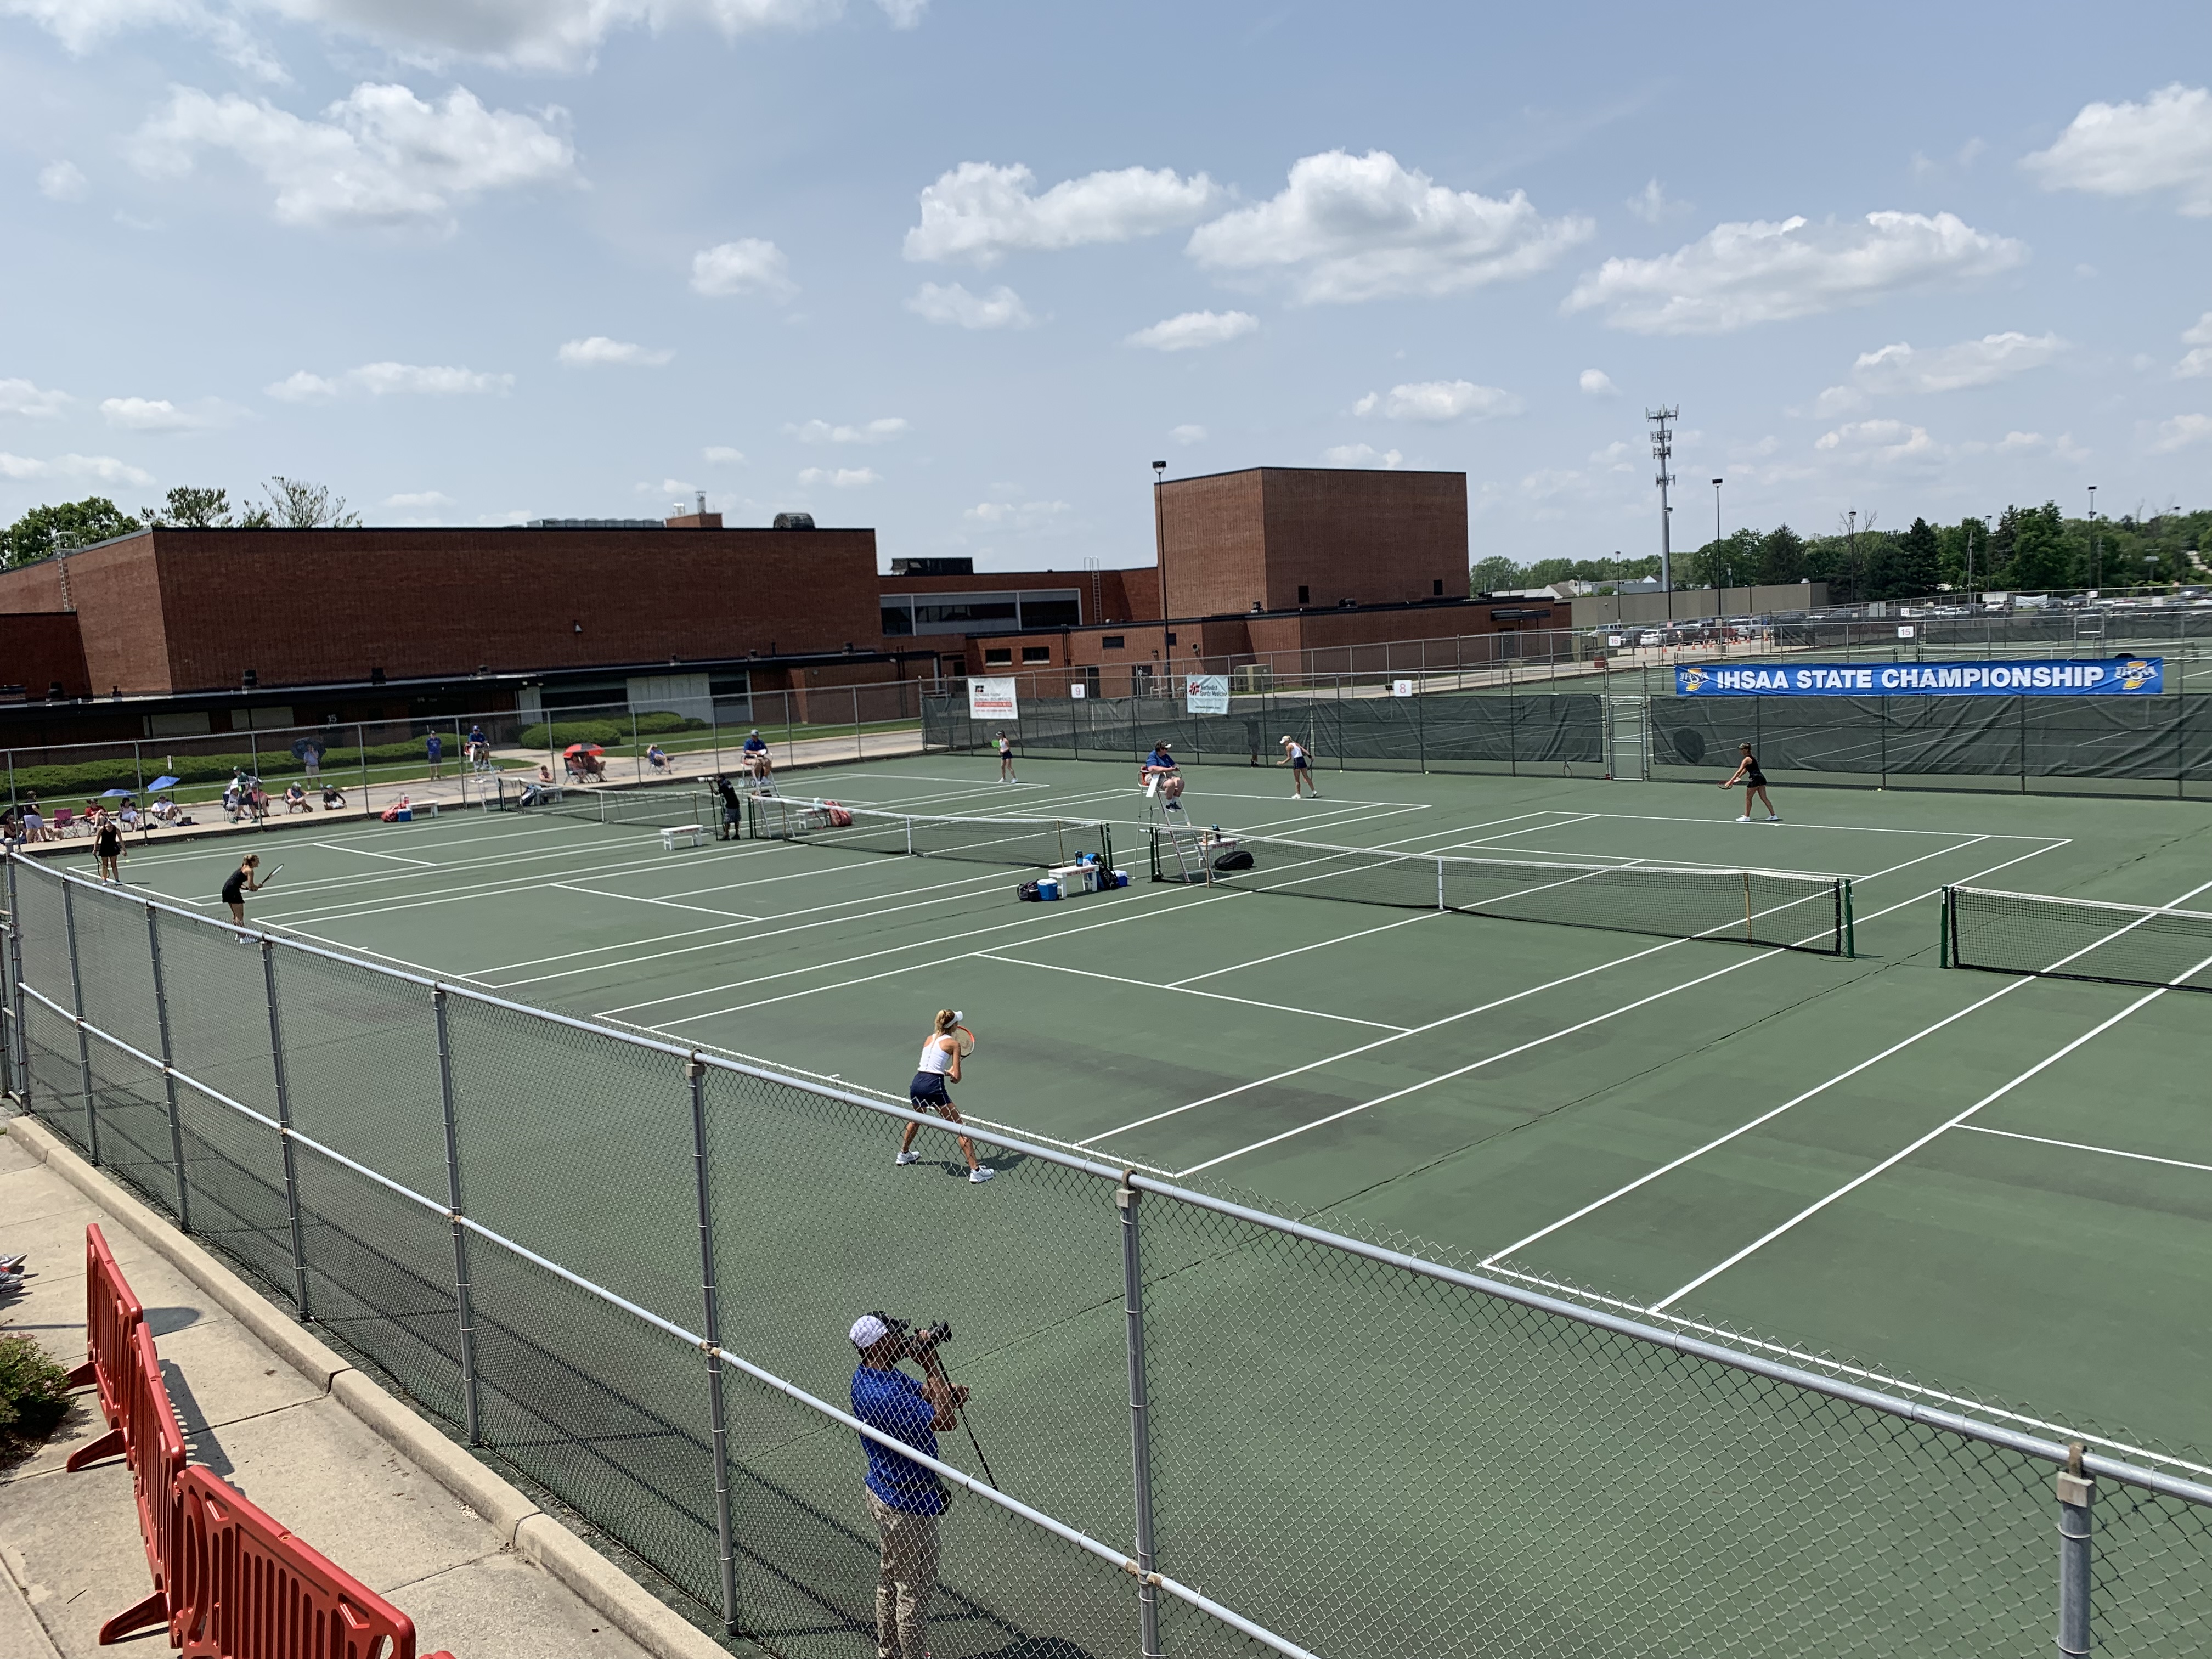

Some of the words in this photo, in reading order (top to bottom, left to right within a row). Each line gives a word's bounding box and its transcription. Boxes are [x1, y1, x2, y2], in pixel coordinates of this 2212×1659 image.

[1717, 670, 1790, 689] IHSAA
[1796, 669, 1872, 689] STATE
[1881, 666, 2104, 688] CHAMPIONSHIP
[1075, 686, 1080, 696] 9
[1400, 682, 1406, 693] 8
[327, 714, 337, 723] 15
